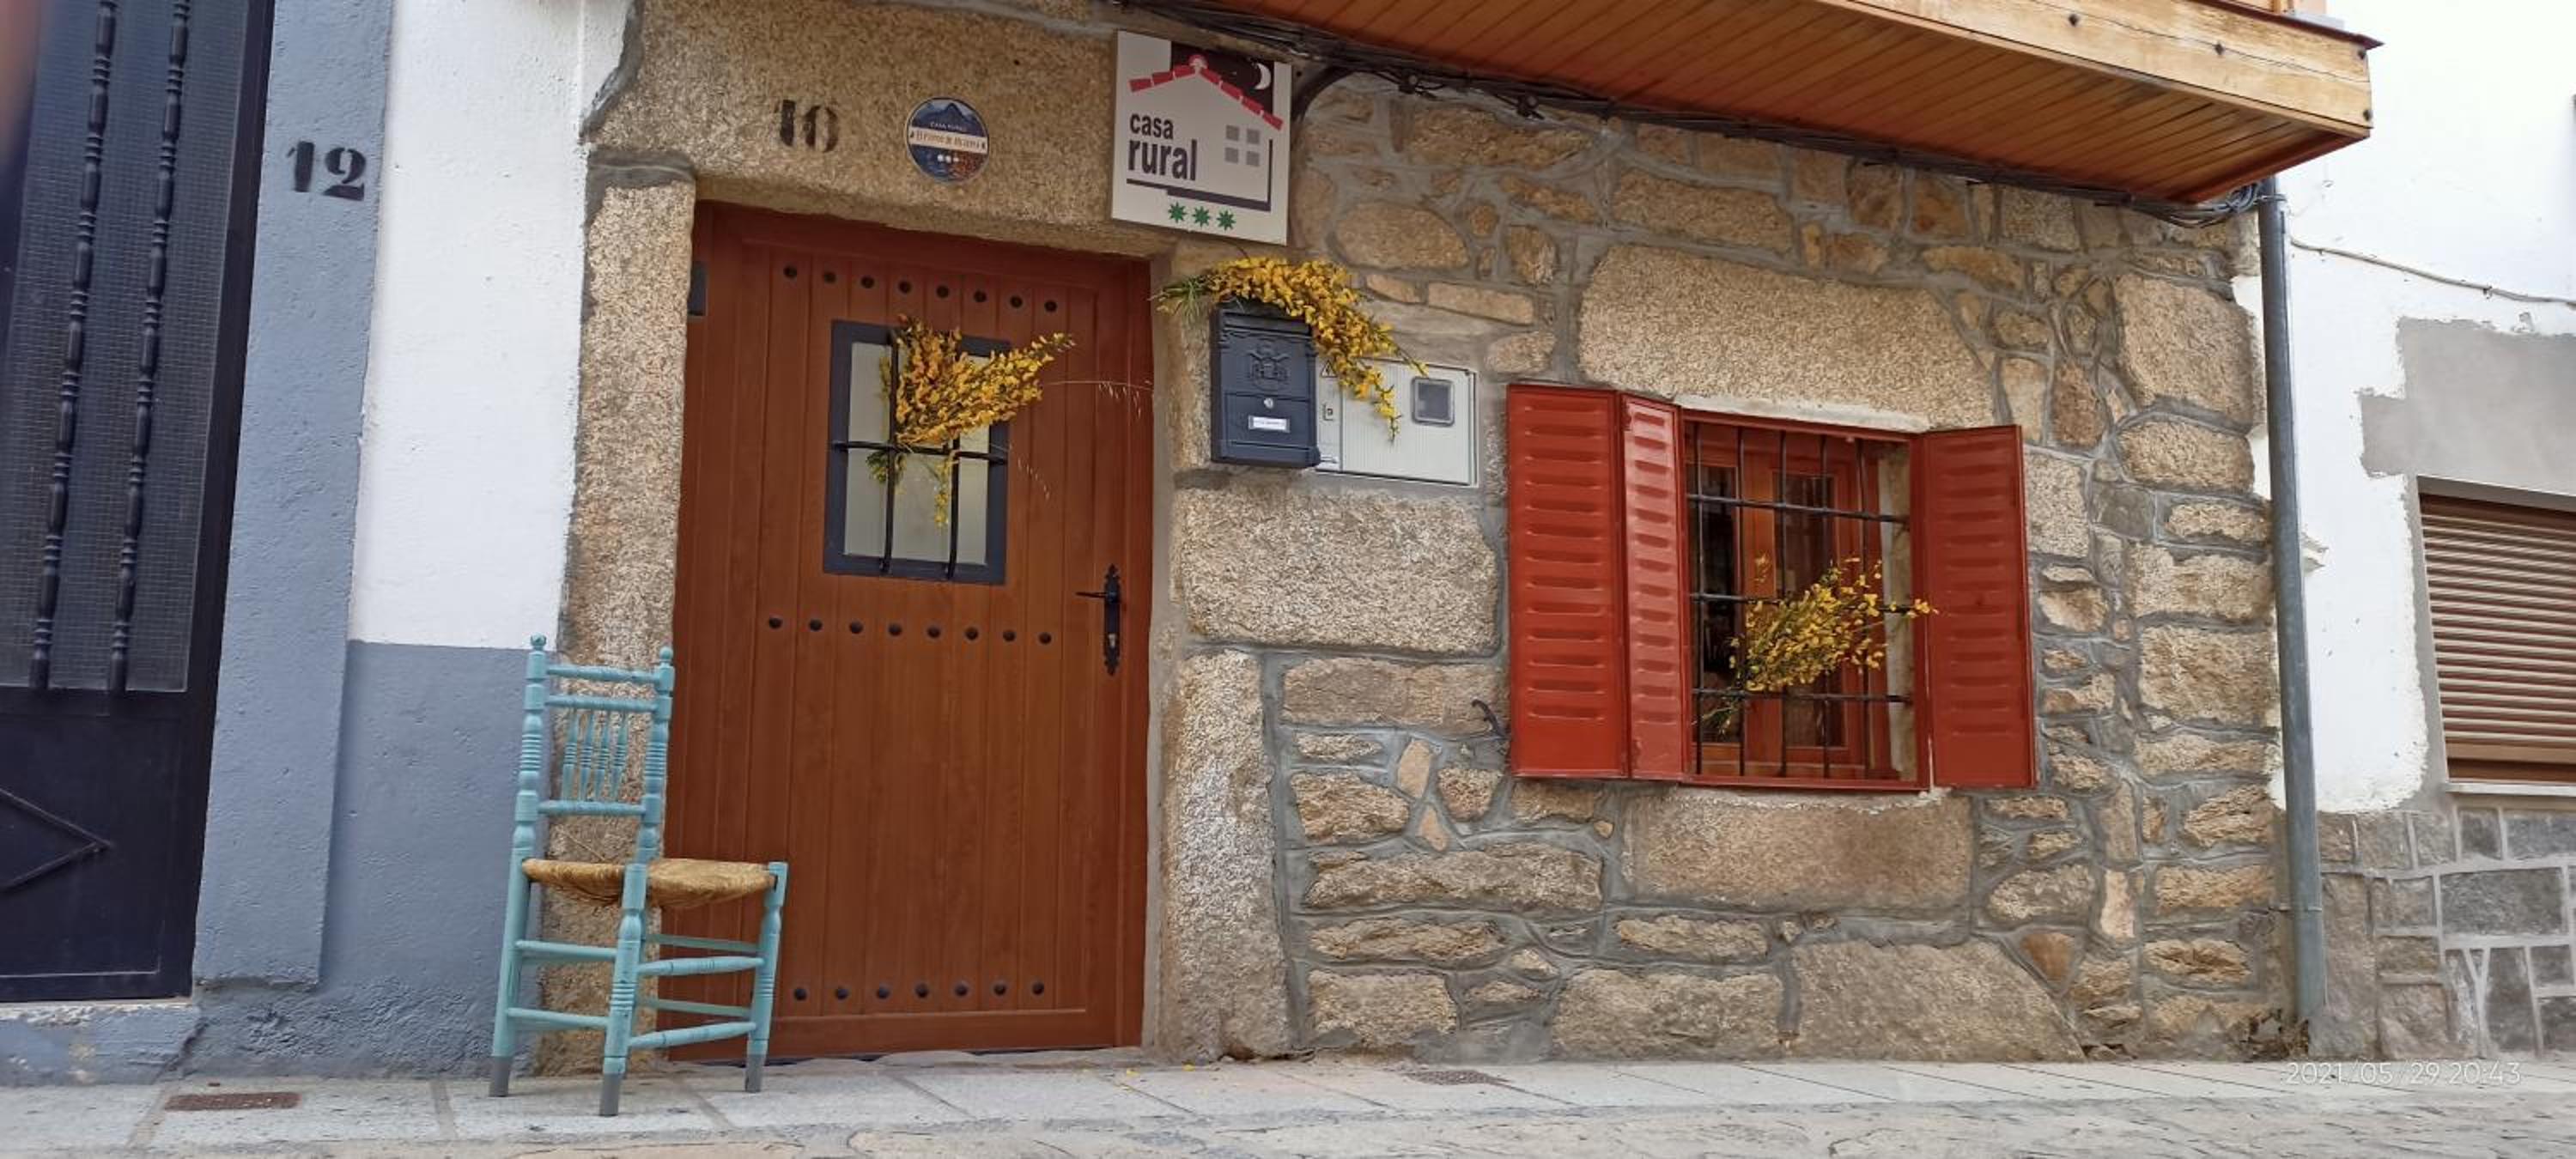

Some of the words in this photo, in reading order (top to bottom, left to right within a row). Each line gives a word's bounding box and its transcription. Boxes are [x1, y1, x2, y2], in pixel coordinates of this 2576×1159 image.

[1129, 112, 1175, 140] casa
[286, 141, 366, 202] 12
[1128, 139, 1197, 181] rural
